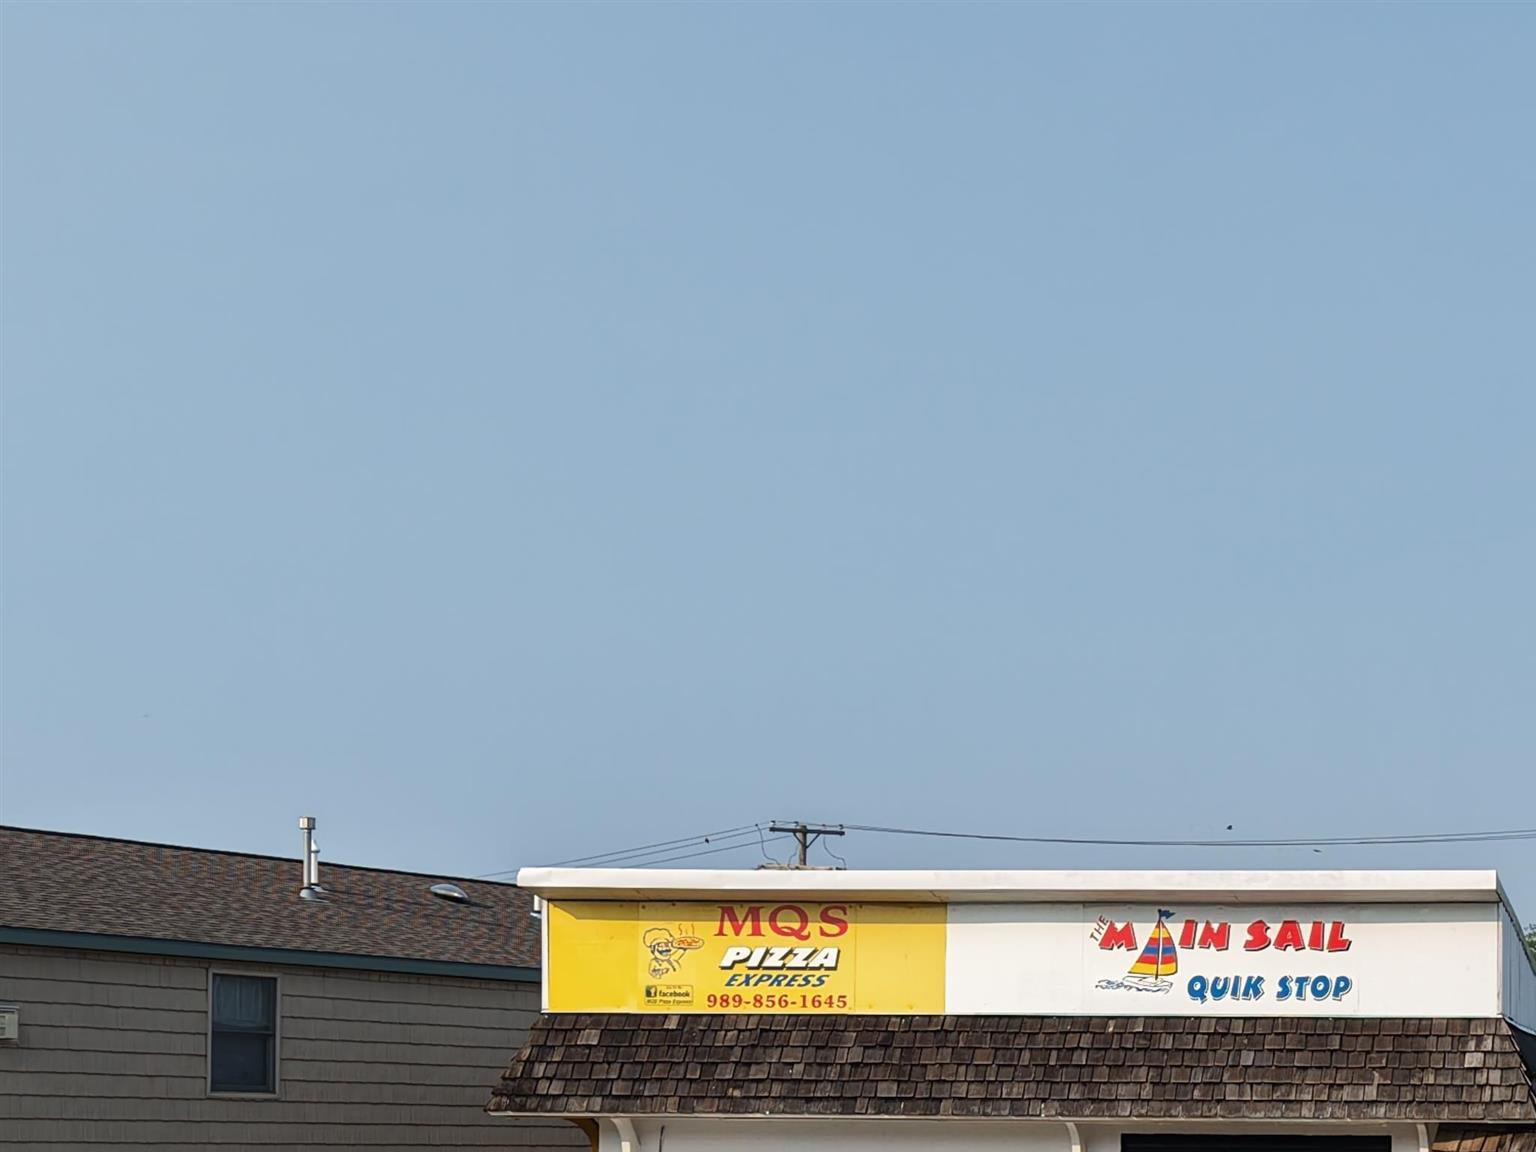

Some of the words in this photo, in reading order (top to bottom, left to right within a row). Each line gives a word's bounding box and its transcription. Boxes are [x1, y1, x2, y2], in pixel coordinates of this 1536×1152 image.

[714, 904, 849, 941] MQS
[1089, 914, 1110, 942] THE
[1243, 919, 1353, 953] SAIL
[719, 946, 841, 971] PIZZA
[725, 974, 830, 987] EXPRESS
[1187, 975, 1265, 1003] QUIK
[1276, 975, 1353, 1001] STOP
[707, 993, 847, 1009] 989-856-1645
